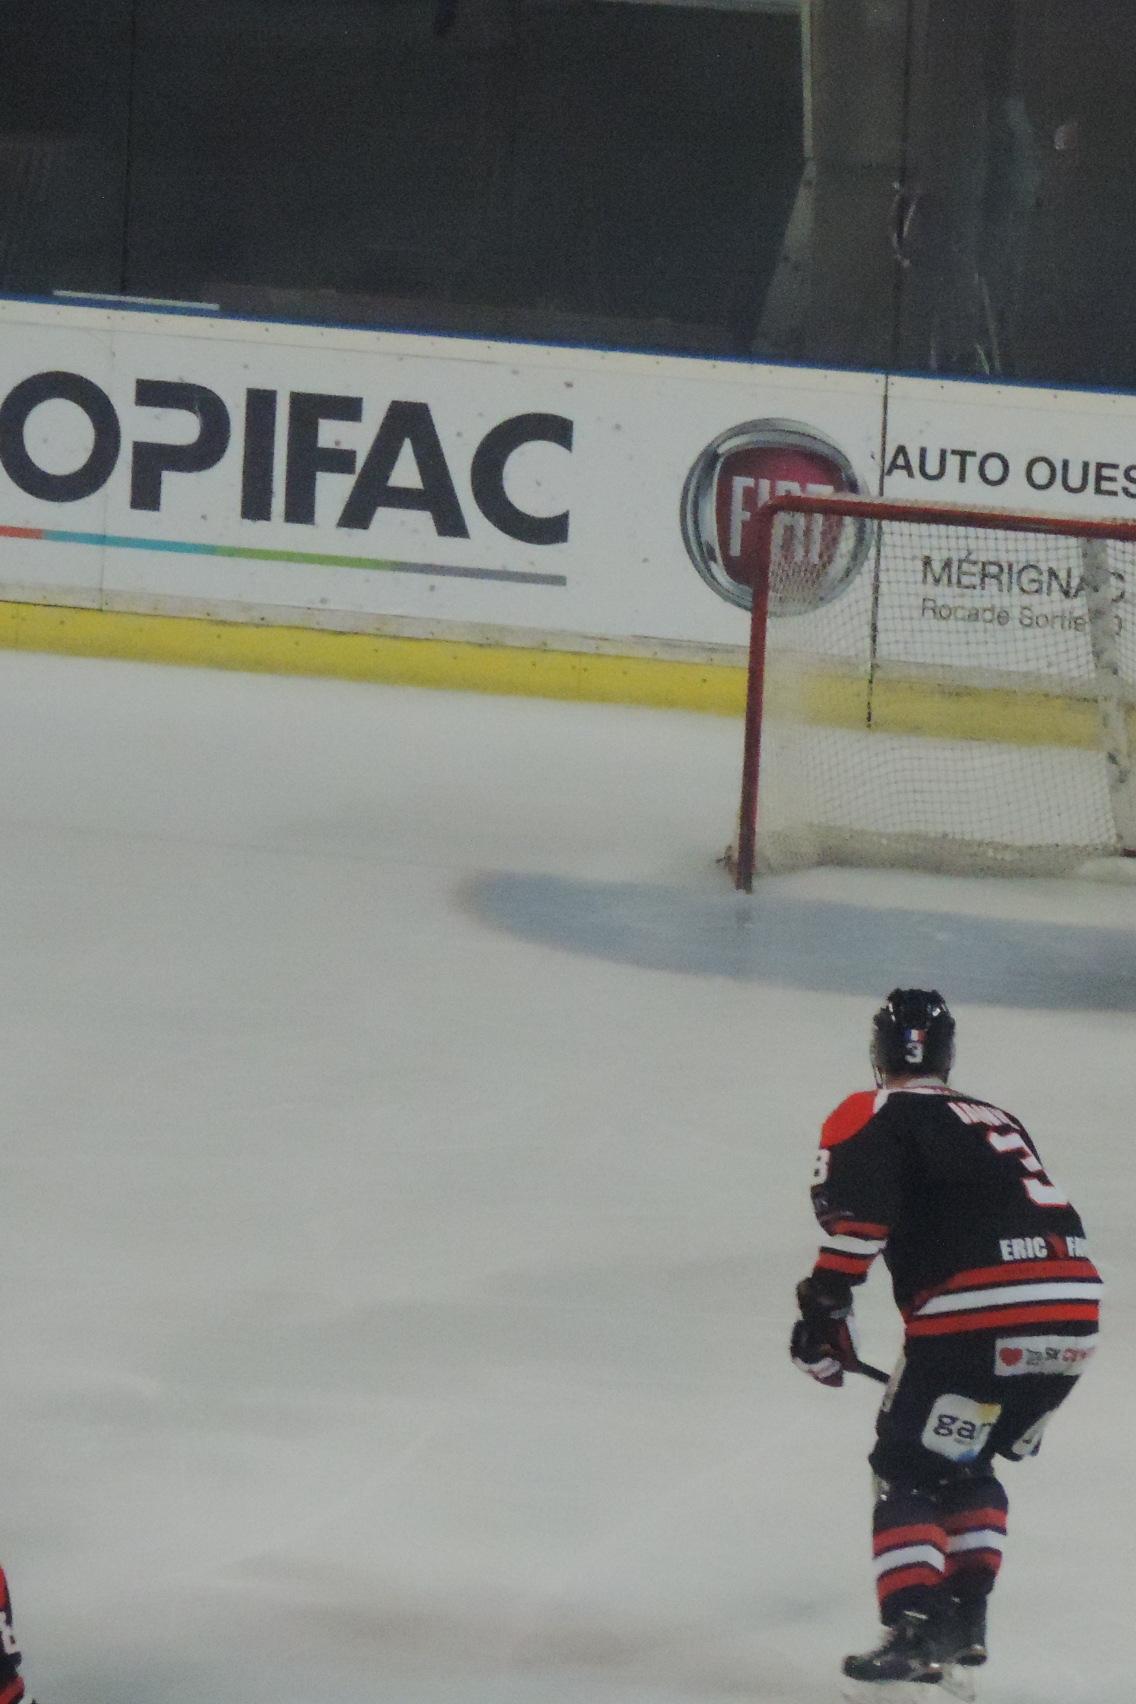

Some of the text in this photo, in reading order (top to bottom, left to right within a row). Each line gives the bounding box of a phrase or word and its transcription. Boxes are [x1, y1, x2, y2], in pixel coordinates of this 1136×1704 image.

[0, 370, 574, 546] OPIFAC
[885, 444, 1010, 487] AUTO
[921, 598, 1010, 626] Rocade
[1019, 605, 1088, 633] Sortie
[904, 1042, 923, 1064] 3
[986, 1130, 1071, 1208] 3
[999, 1236, 1048, 1261] ERIC
